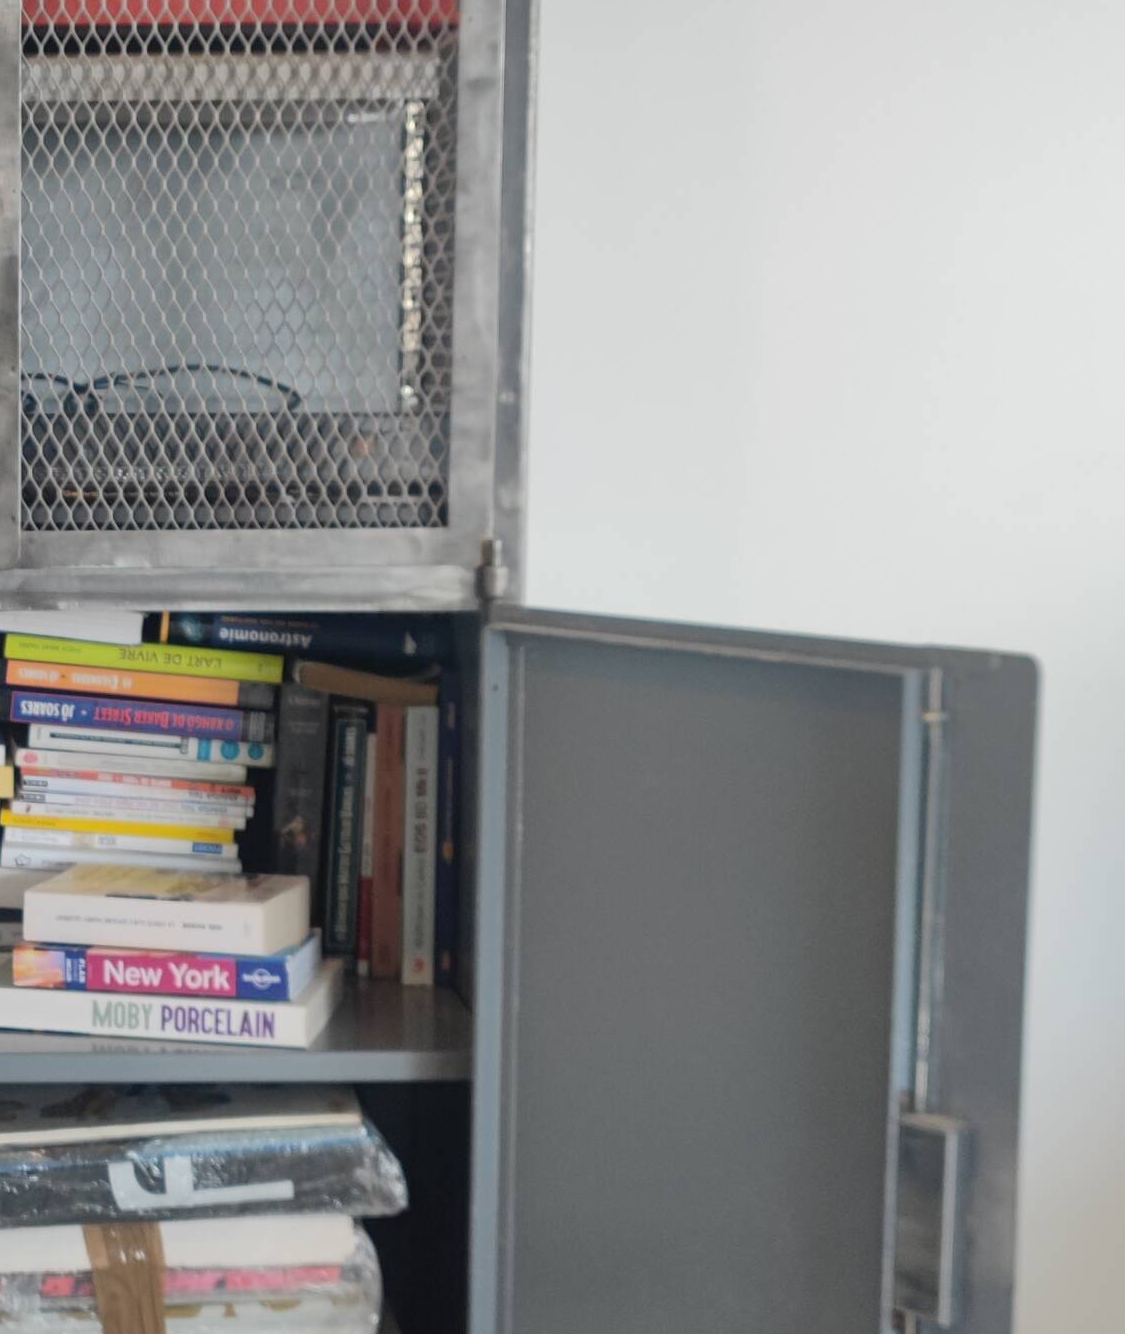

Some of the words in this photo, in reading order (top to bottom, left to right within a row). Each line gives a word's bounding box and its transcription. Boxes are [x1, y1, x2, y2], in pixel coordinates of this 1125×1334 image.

[219, 627, 313, 648] Astronomie
[119, 649, 159, 664] VIVRE
[163, 653, 183, 666] DE
[187, 656, 222, 670] L'ART
[20, 701, 60, 716] SOARES
[61, 704, 75, 722] JÔ
[93, 707, 132, 725] STREET
[135, 711, 171, 729] BAKER
[187, 716, 223, 732] XANGÔ
[102, 960, 163, 986] New
[170, 965, 230, 991] York
[92, 999, 153, 1030] MOBY
[160, 1004, 276, 1039] PORCELAIN
